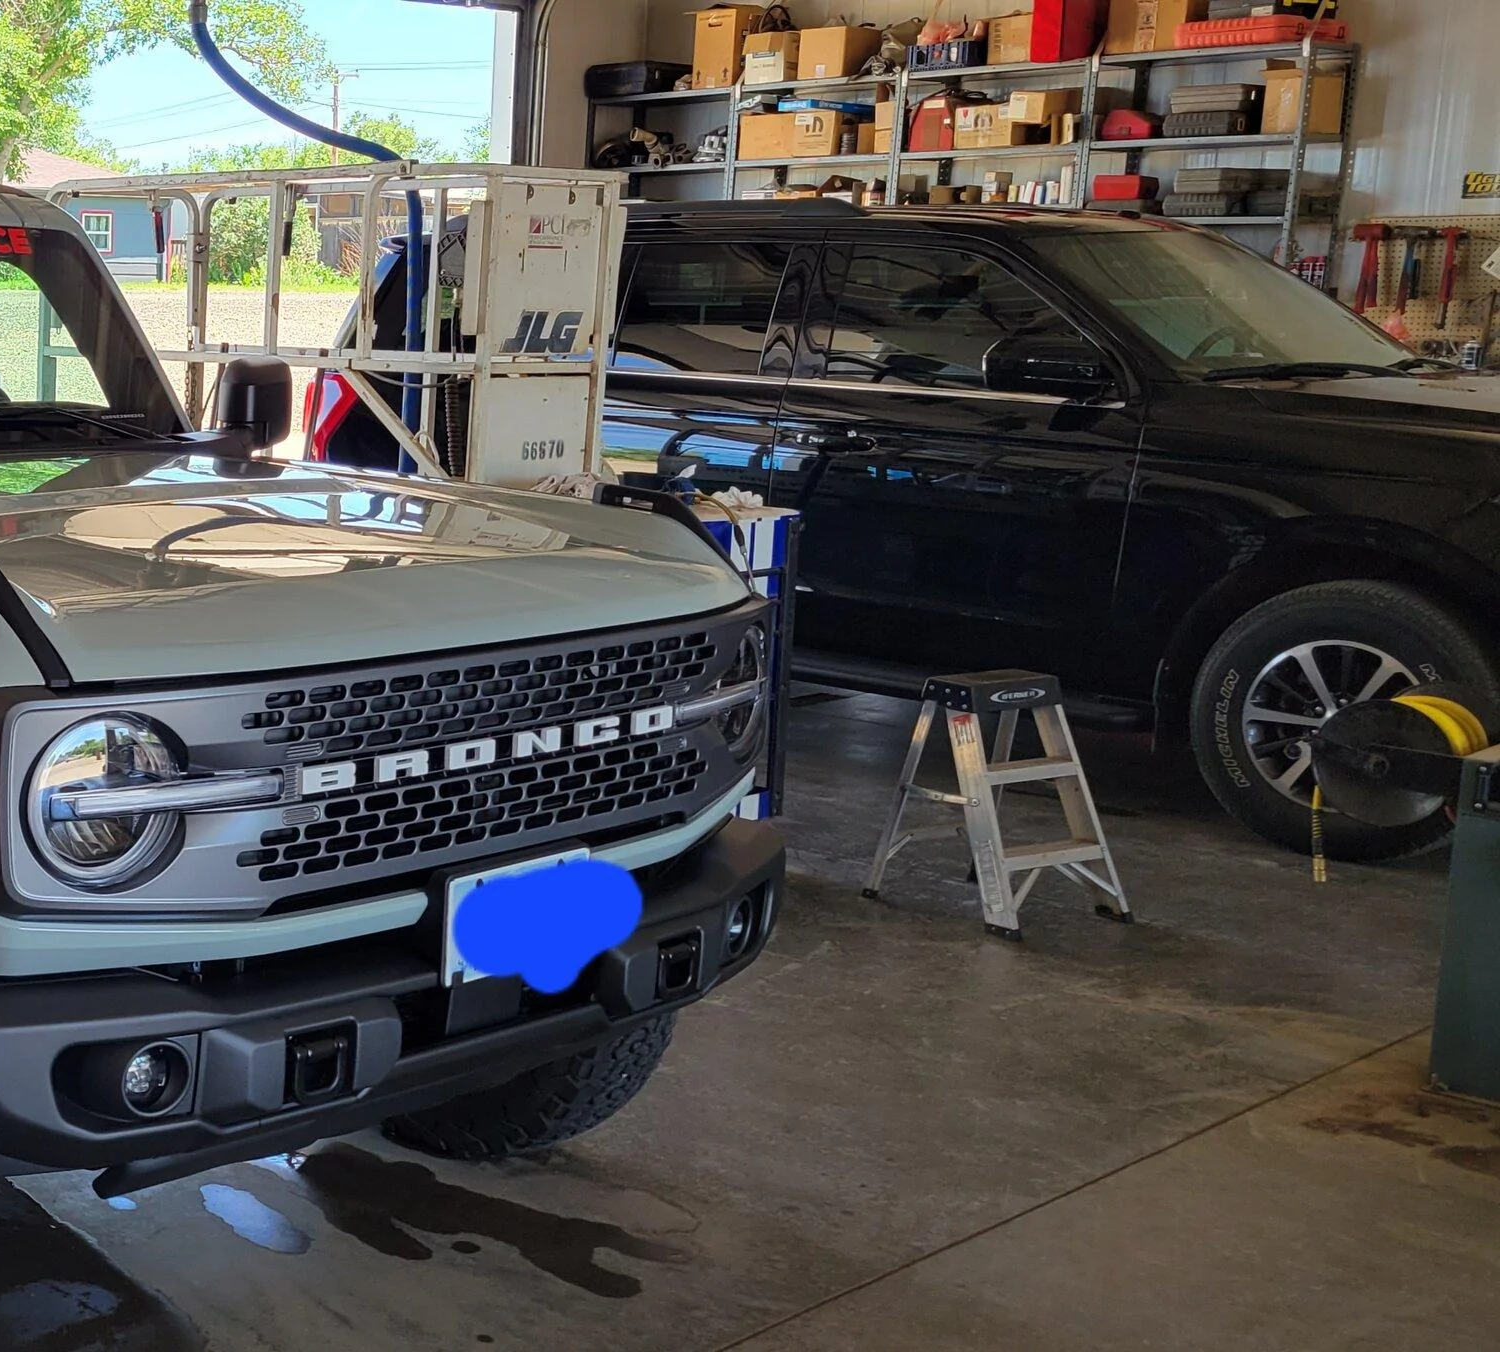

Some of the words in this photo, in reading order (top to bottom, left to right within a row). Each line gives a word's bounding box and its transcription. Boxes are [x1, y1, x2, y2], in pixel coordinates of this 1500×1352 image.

[501, 310, 584, 353] JLG
[301, 704, 674, 795] BRONCO
[1211, 669, 1250, 788] MICHELIN
